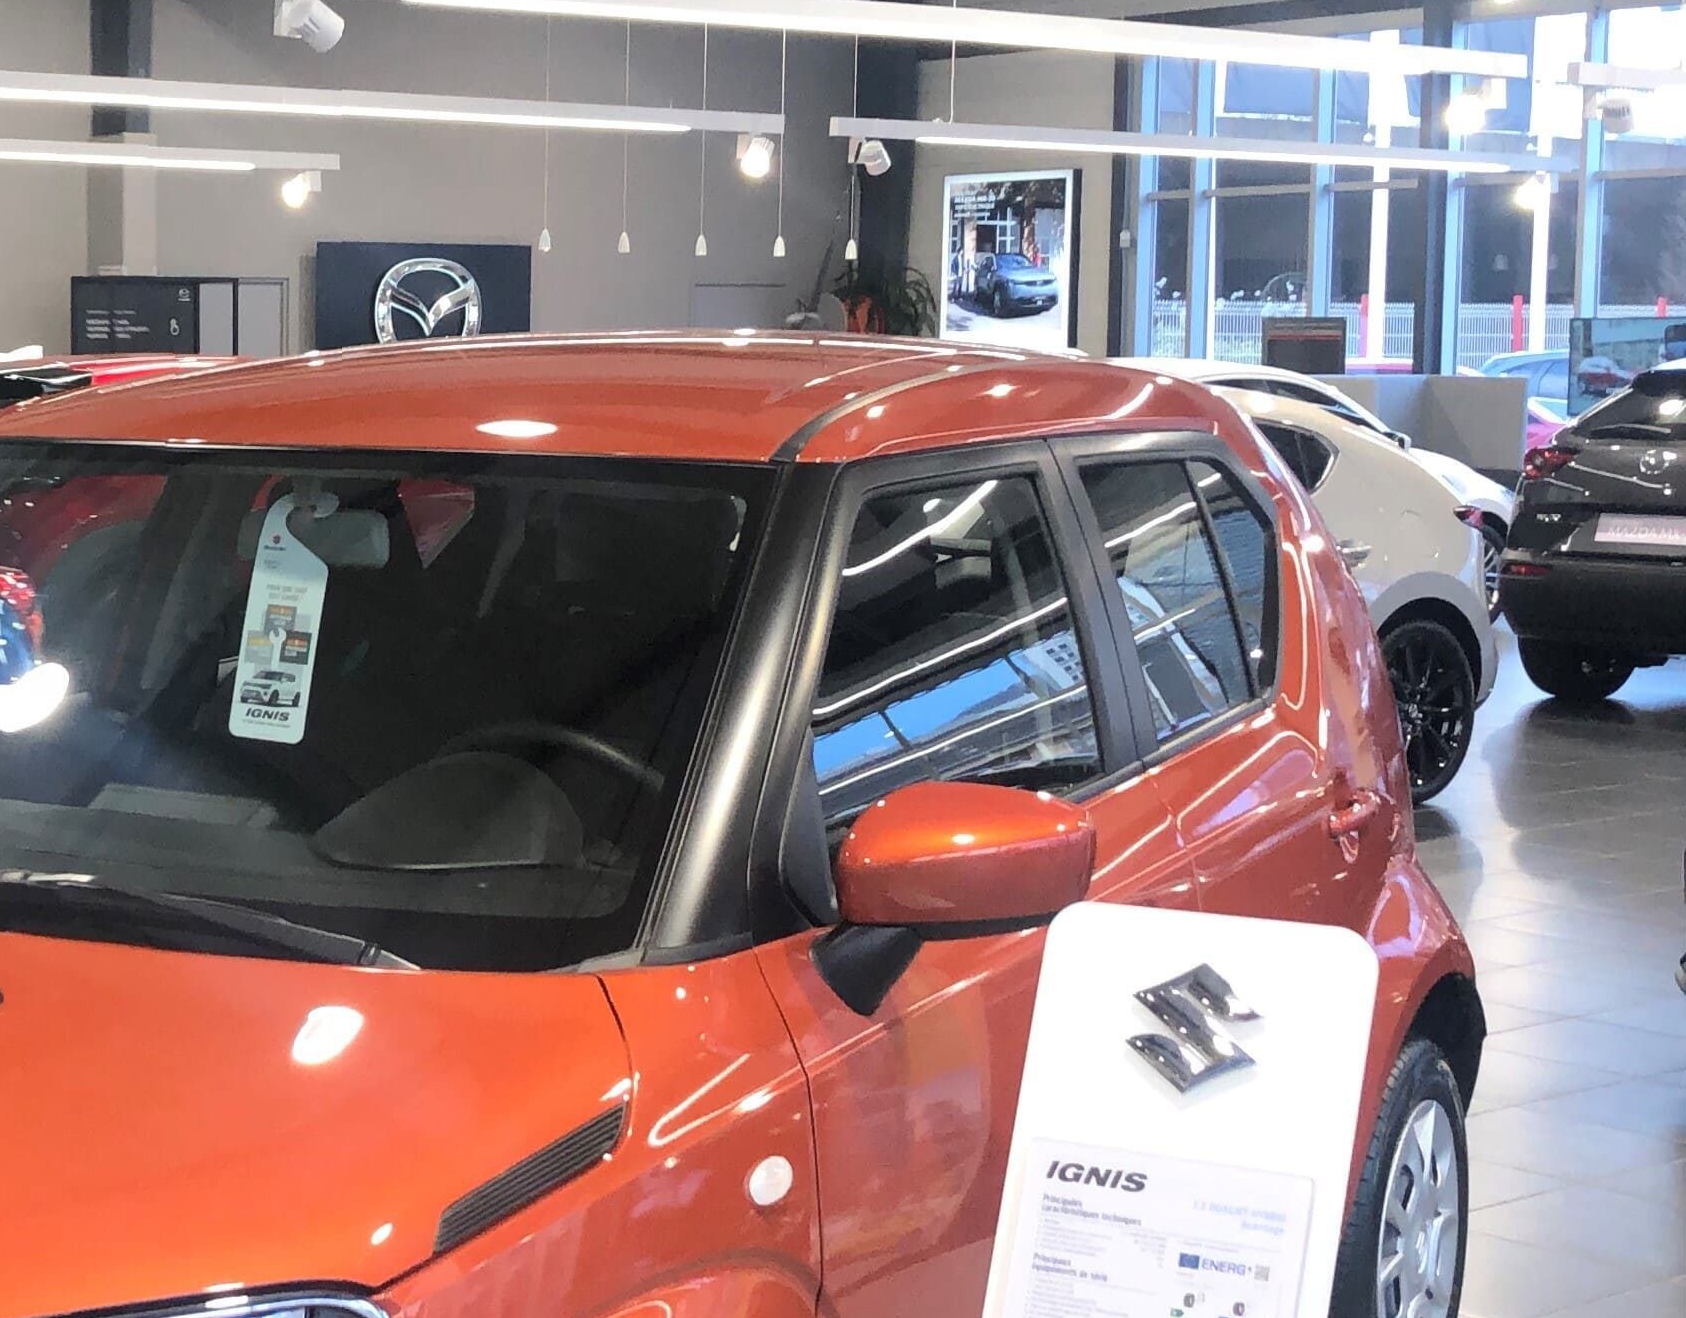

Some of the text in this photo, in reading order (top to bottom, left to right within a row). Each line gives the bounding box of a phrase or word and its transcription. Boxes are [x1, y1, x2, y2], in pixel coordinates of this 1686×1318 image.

[245, 707, 290, 722] IGNIS
[1046, 1160, 1148, 1193] IGNIS
[1201, 1258, 1246, 1276] ENERG
